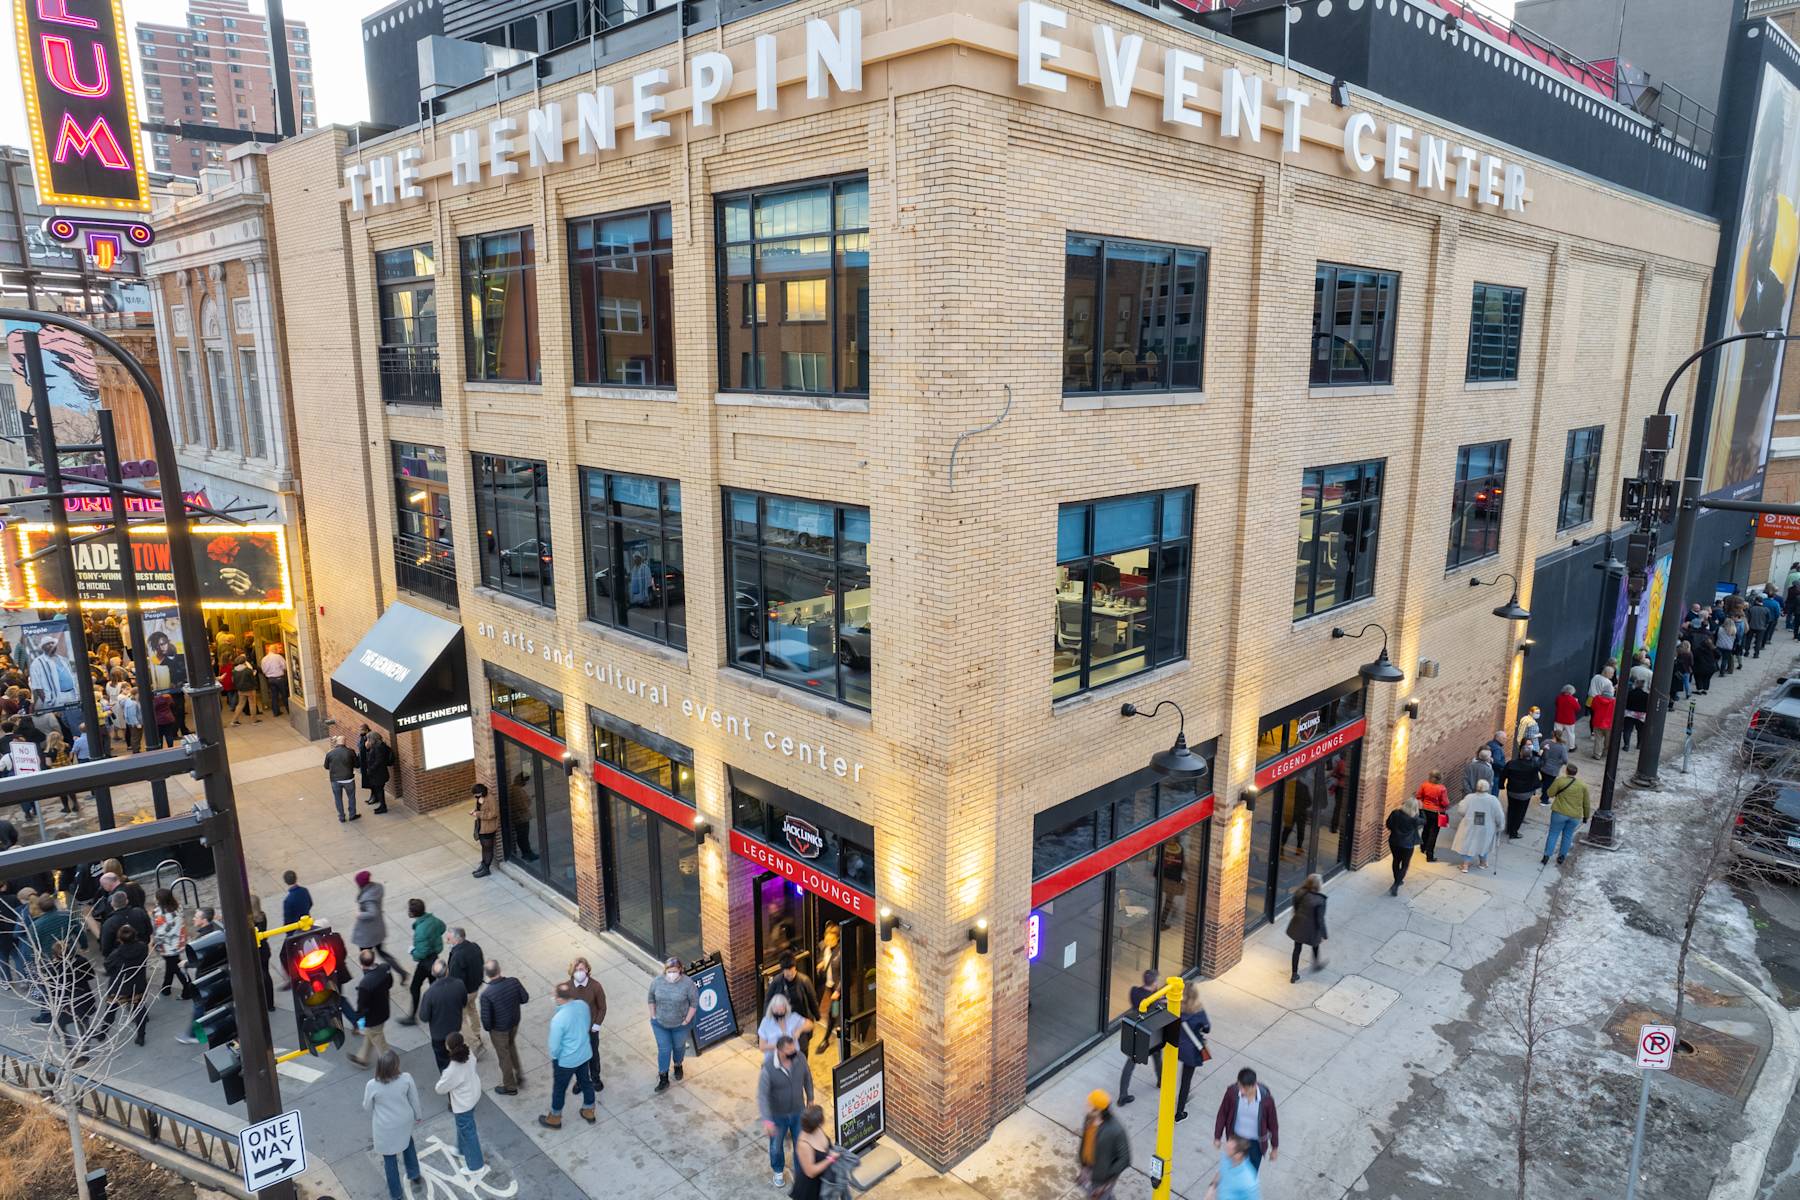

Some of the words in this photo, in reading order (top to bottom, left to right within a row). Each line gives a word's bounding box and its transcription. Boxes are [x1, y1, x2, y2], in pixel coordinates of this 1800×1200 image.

[345, 147, 423, 212] THE
[450, 7, 862, 186] HENNEPIN
[1018, 1, 1309, 153] EVENT
[1344, 112, 1530, 212] CENTER
[23, 626, 48, 636] People
[360, 649, 378, 667] THE
[370, 654, 412, 683] HENNEPIN
[353, 697, 368, 713] 900
[397, 715, 418, 727] THE
[418, 704, 468, 722] HENNEPIN
[478, 620, 495, 639] an
[502, 630, 535, 655] arts
[543, 645, 574, 669] and
[584, 658, 668, 707] cultural
[682, 698, 752, 741] event
[764, 728, 864, 783] center
[18, 747, 29, 755] NO
[1272, 753, 1307, 779] LEGEND
[1311, 734, 1344, 758] LOUNGE
[782, 821, 802, 839] JACK
[743, 842, 794, 875] LEGEND
[802, 870, 861, 910] LOUNGE
[842, 1089, 880, 1118] LEGEND
[249, 1119, 292, 1146] ONE
[251, 1135, 294, 1164] WAY
